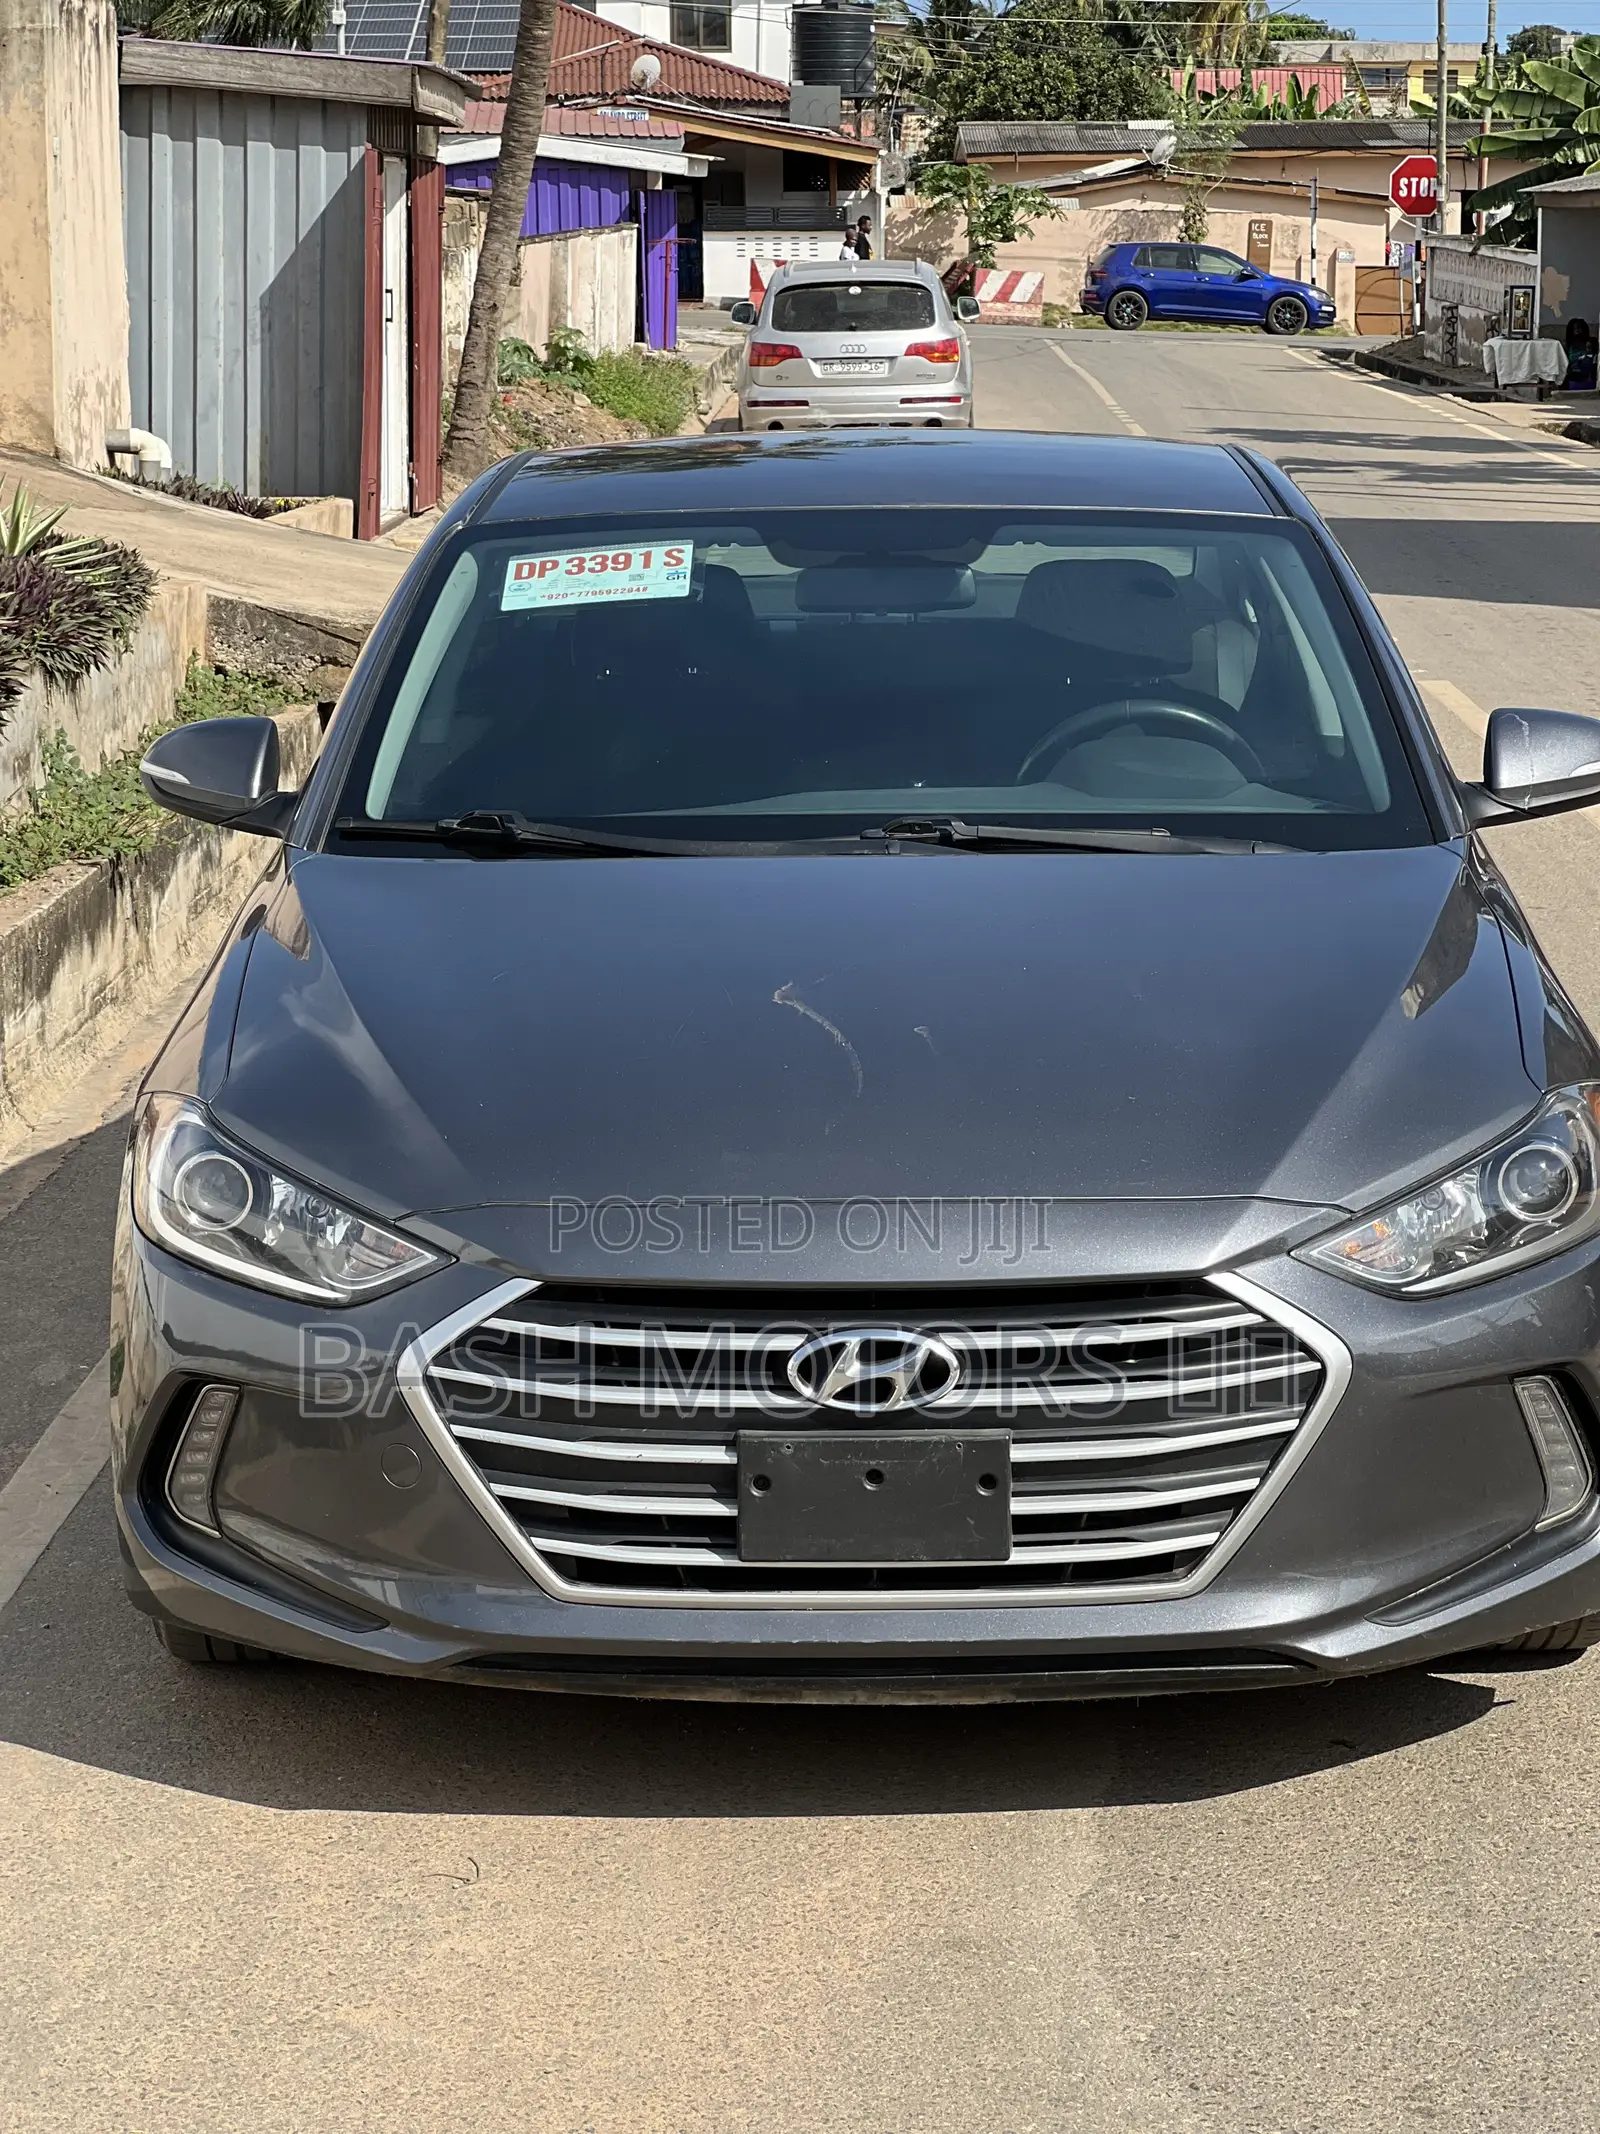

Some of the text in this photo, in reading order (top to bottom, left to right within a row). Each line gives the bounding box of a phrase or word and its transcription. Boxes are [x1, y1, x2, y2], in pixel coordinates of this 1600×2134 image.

[1251, 223, 1267, 232] ICE
[514, 548, 685, 580] DP 3391 S
